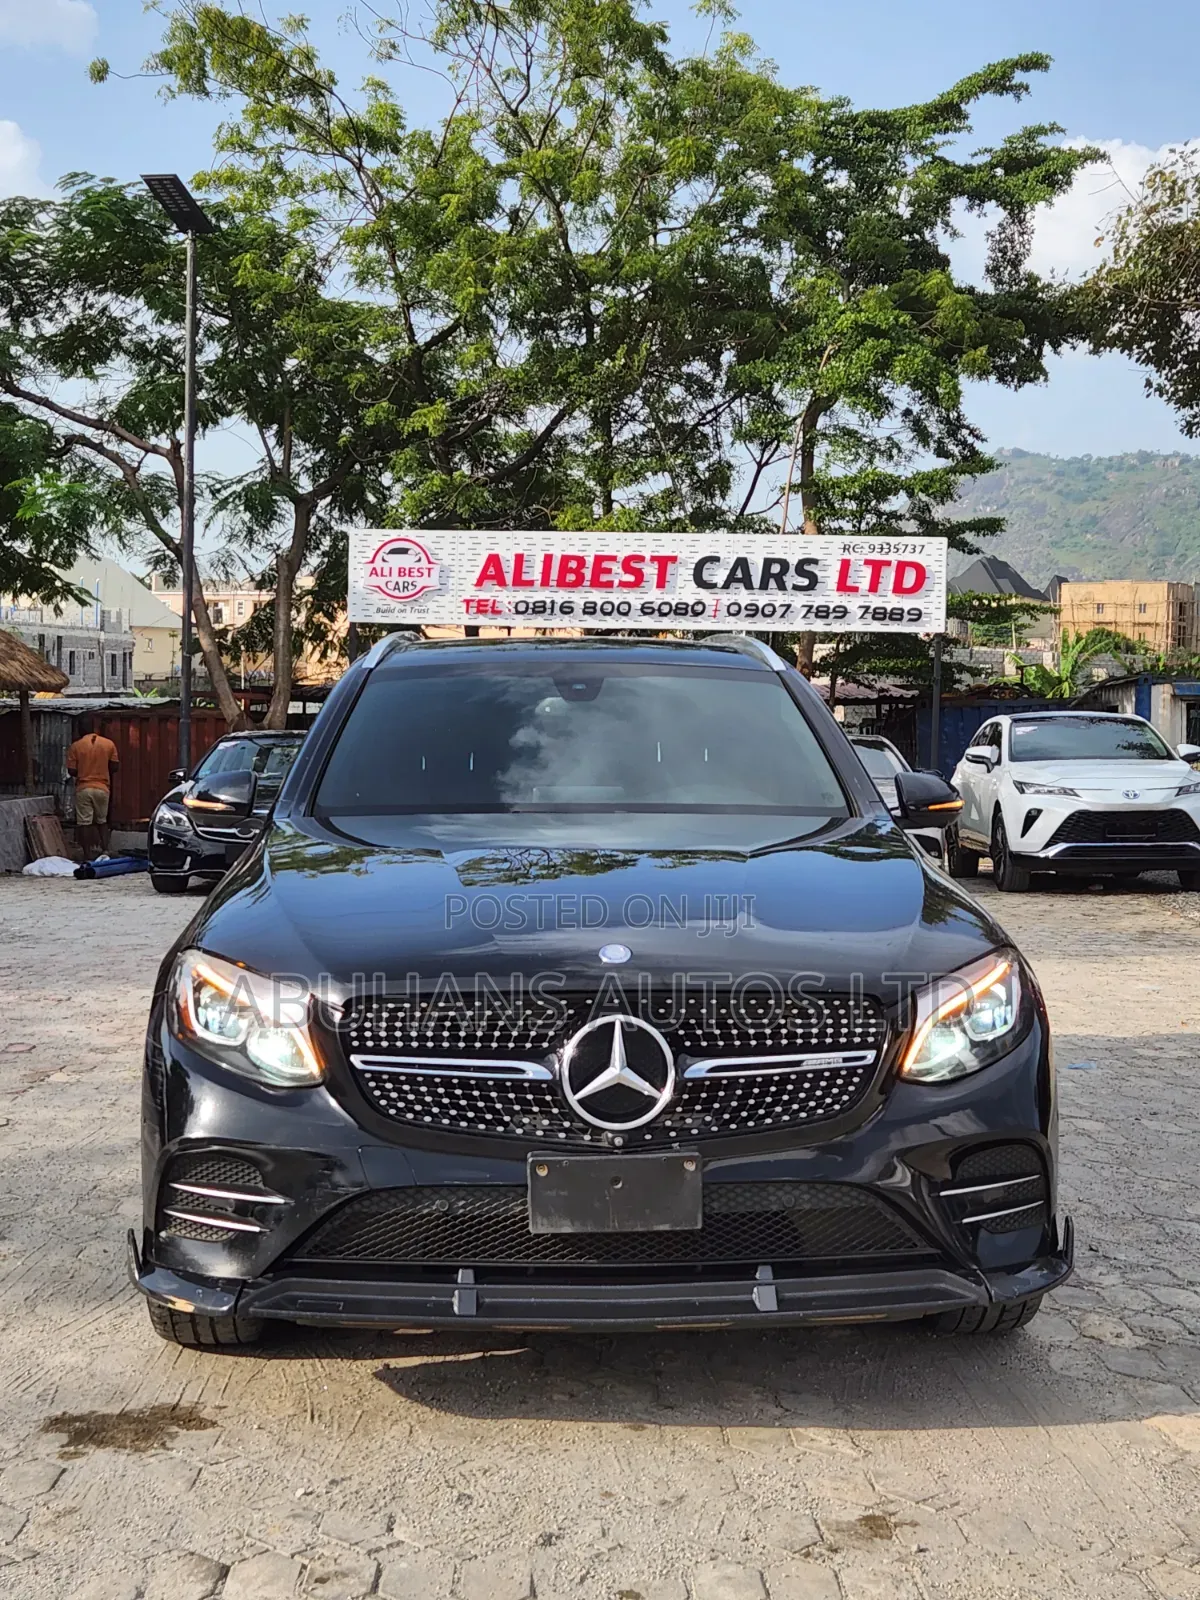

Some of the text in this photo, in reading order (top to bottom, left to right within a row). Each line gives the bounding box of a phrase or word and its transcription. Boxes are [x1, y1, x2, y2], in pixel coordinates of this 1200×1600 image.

[369, 566, 434, 578] ALI BEST
[474, 553, 927, 595] ALIBEST CARS LTD
[385, 580, 417, 593] CARS
[375, 606, 397, 614] Build
[409, 606, 430, 614] Trust
[514, 600, 575, 616] 0816
[581, 600, 632, 617] 800
[640, 600, 706, 618] 6080
[726, 602, 792, 619] 0907
[800, 604, 849, 621] 789
[857, 604, 923, 623] 7889
